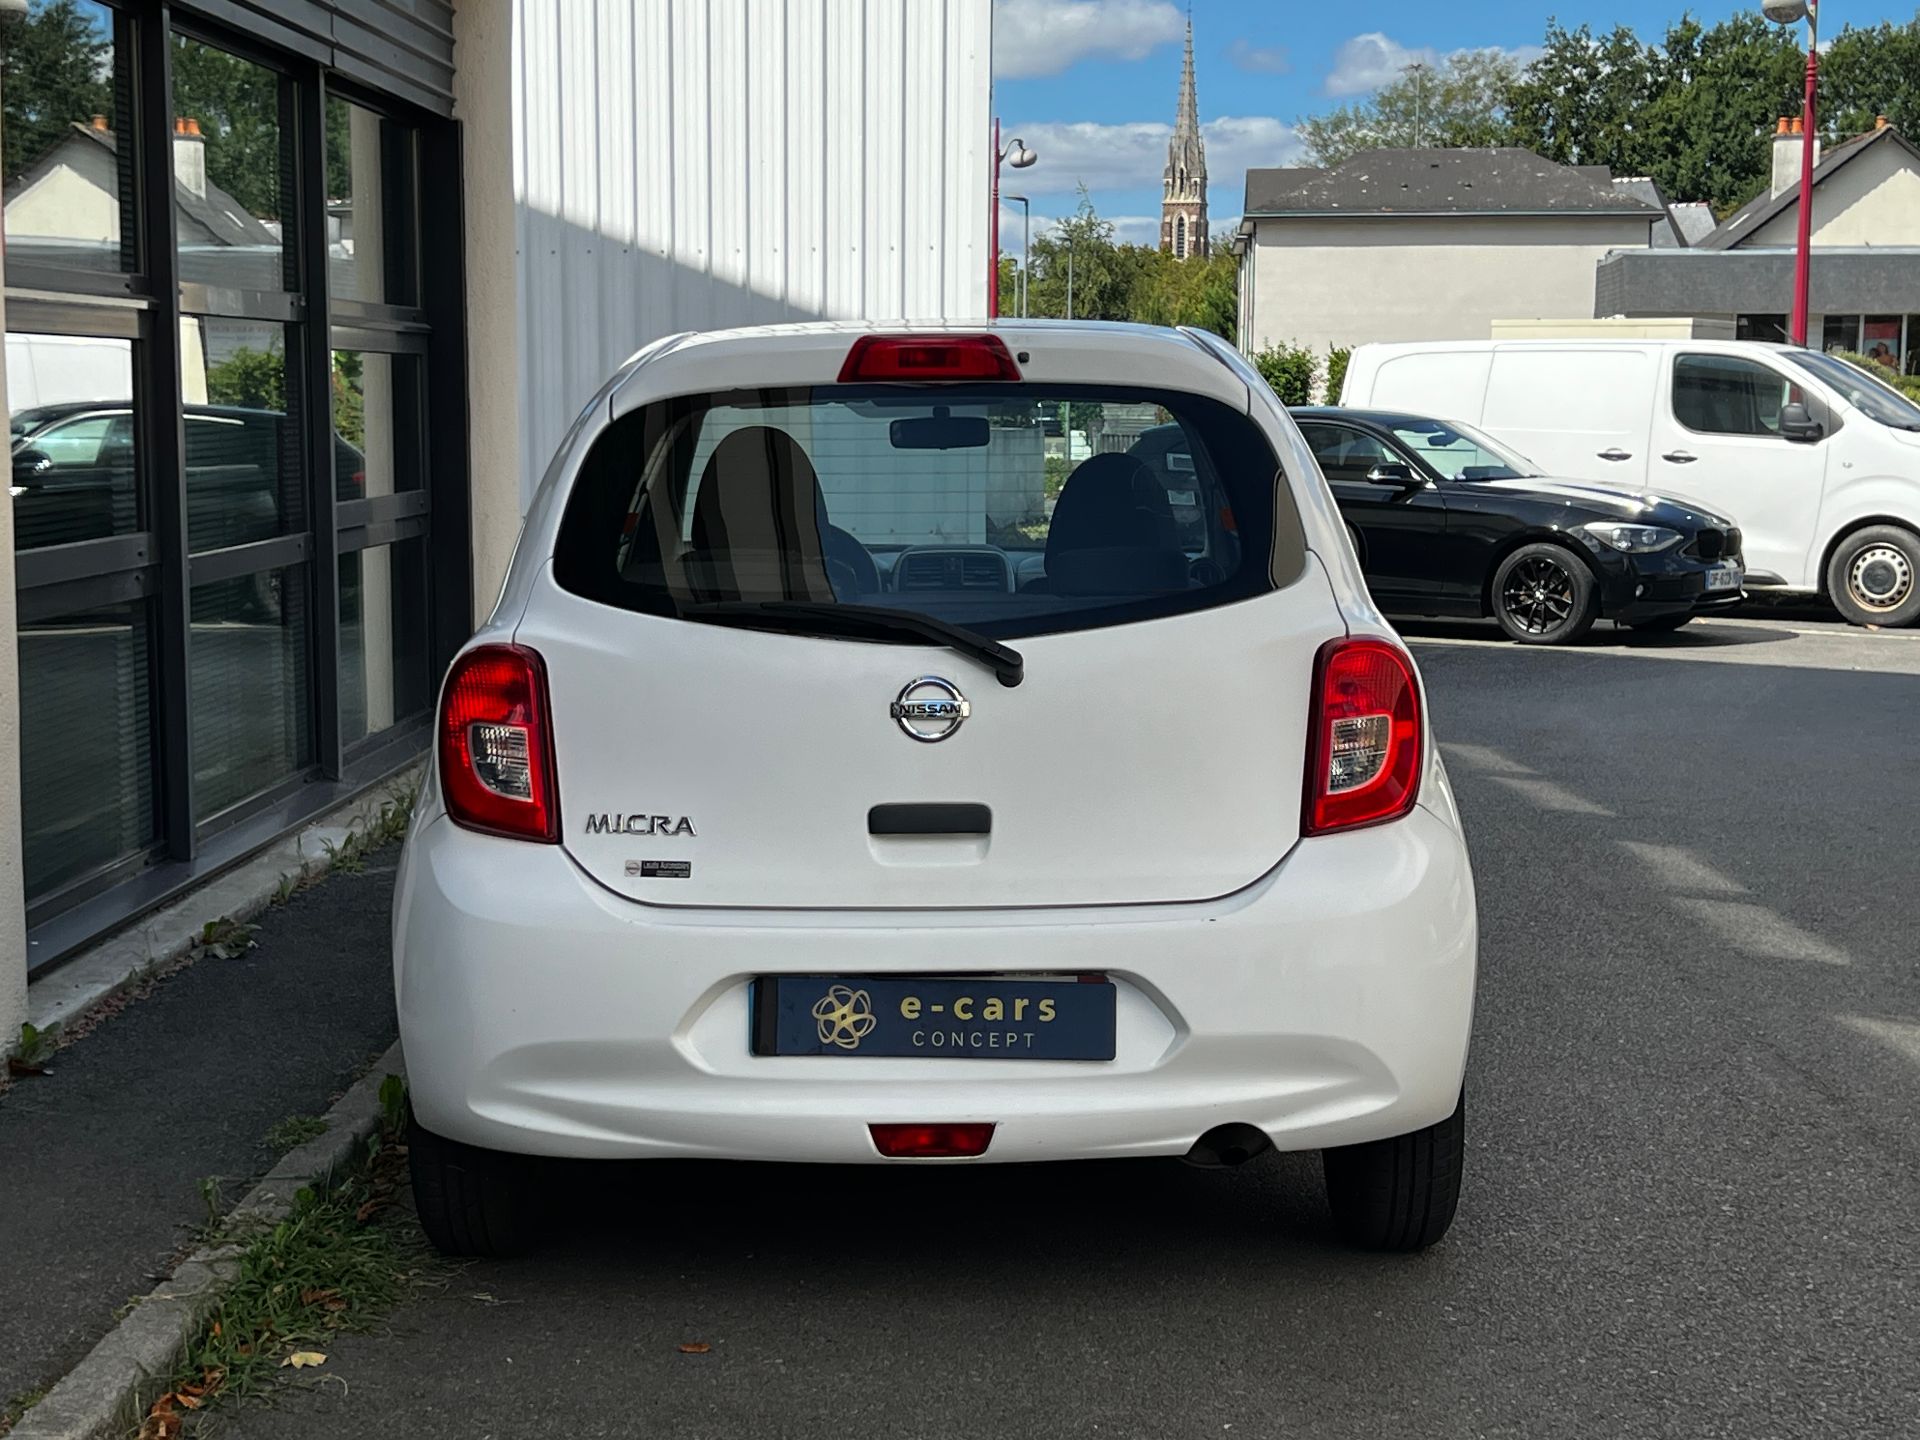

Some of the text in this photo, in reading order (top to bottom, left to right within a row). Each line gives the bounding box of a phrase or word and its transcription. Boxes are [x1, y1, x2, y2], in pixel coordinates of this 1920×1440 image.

[900, 704, 962, 715] NISSAN
[585, 813, 698, 837] MICRA
[900, 995, 1057, 1023] e-cars
[912, 1030, 1037, 1049] CONCEPT
